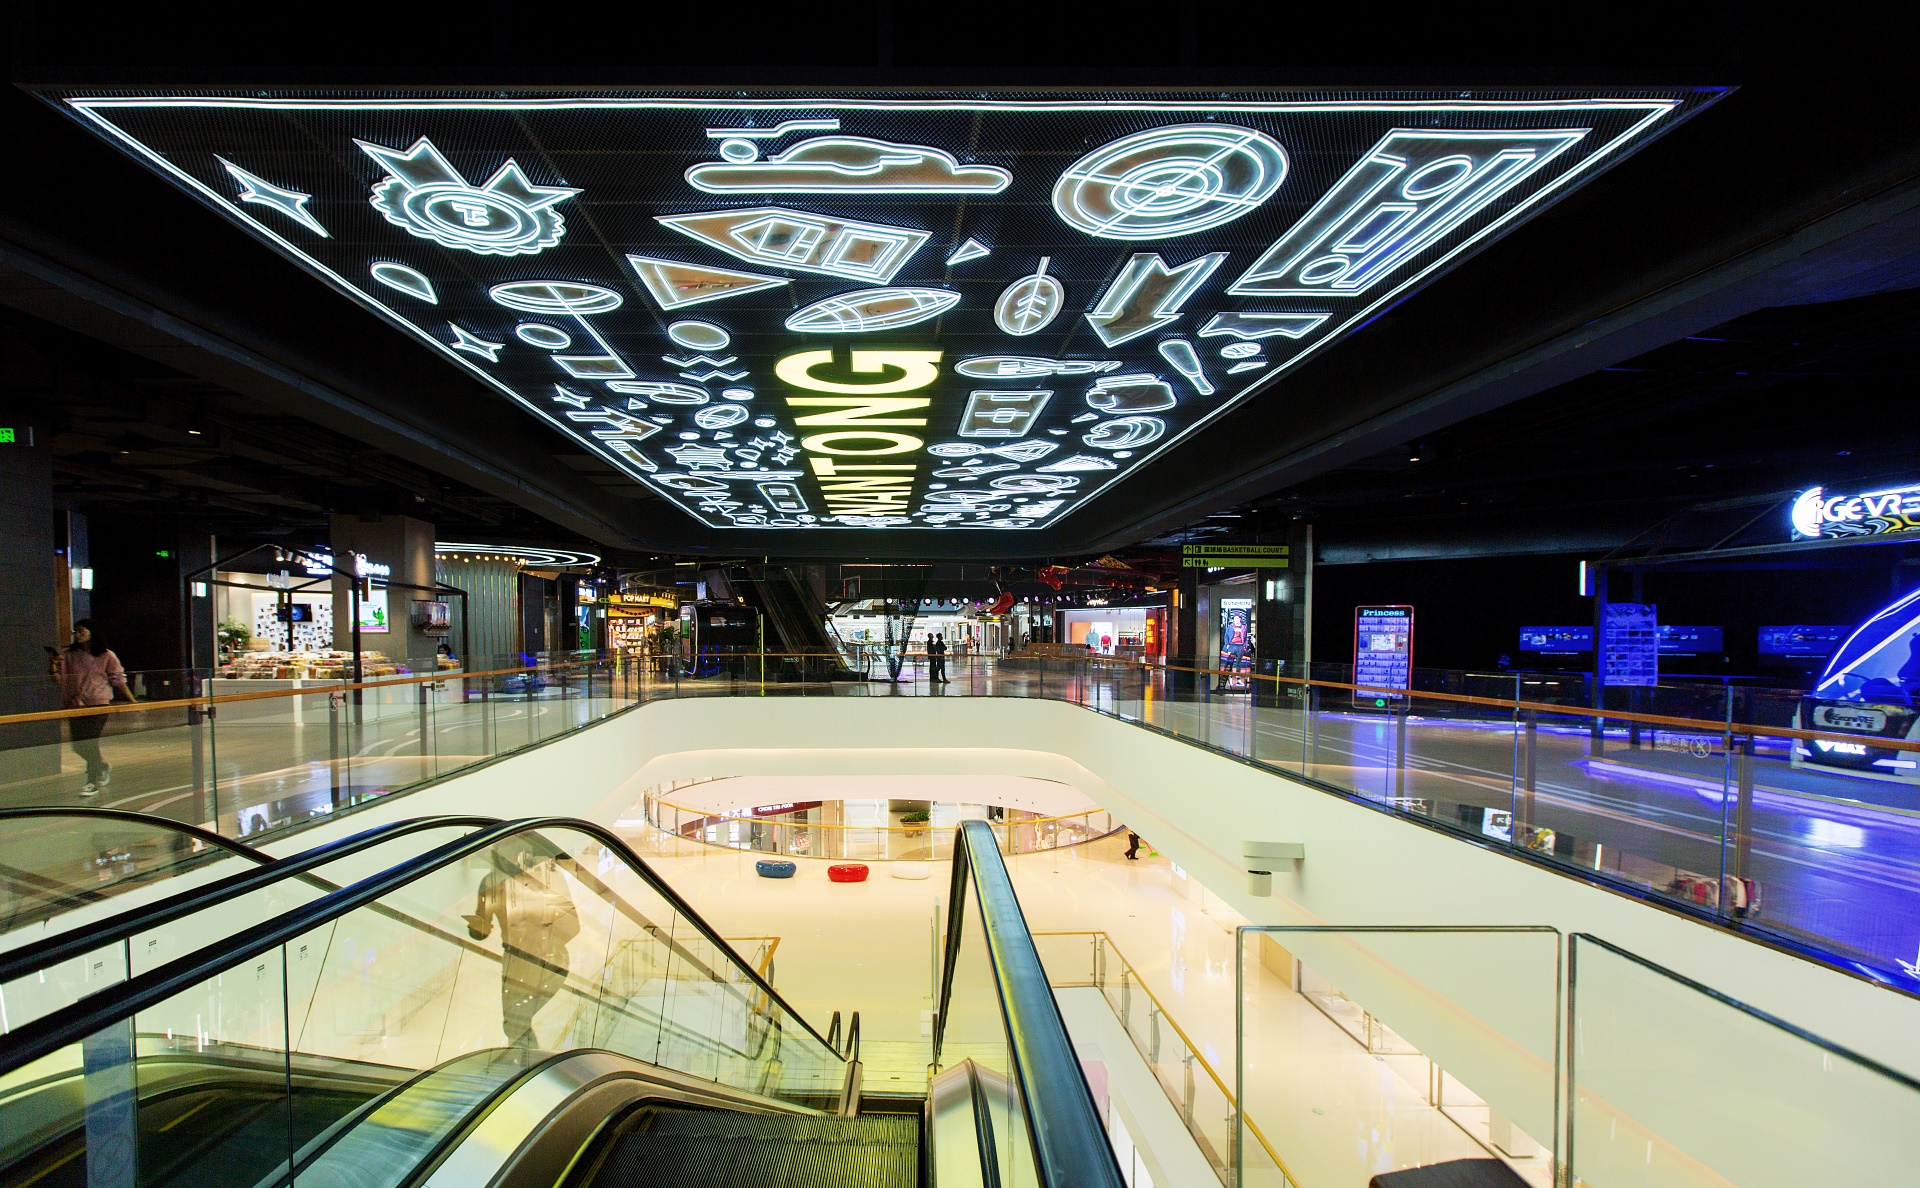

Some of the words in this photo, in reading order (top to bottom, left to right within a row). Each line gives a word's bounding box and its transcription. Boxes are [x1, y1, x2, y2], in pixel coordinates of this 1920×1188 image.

[774, 350, 944, 515] NANTONG
[623, 594, 634, 602] POP
[634, 595, 650, 603] MART
[1363, 609, 1405, 617] Princess
